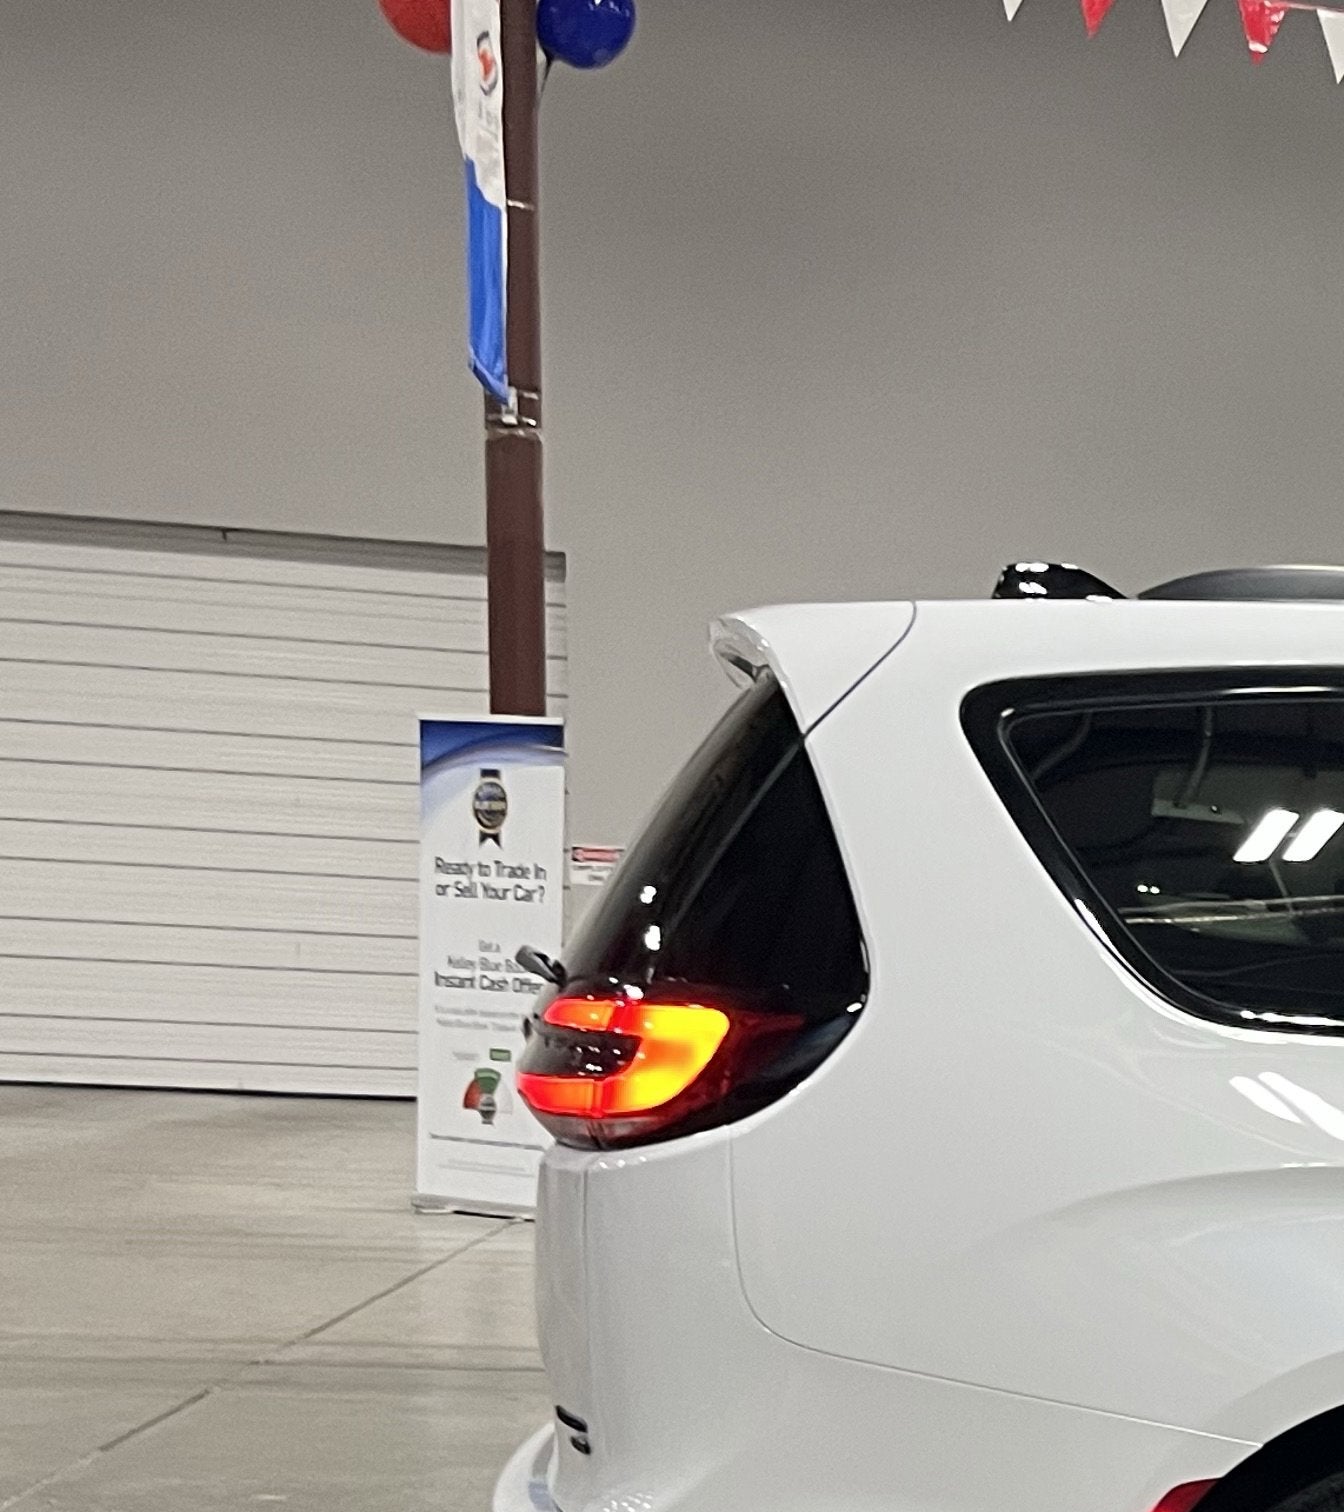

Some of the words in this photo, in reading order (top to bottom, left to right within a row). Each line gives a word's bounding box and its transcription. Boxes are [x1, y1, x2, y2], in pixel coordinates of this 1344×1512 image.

[434, 856, 473, 882] Ready
[478, 861, 492, 877] to
[494, 859, 530, 880] Trade
[435, 884, 450, 897] or
[454, 881, 478, 899] Sell
[481, 882, 511, 901] Your
[513, 883, 545, 903] Car?
[434, 970, 476, 989] Instant
[479, 974, 508, 992] Cash
